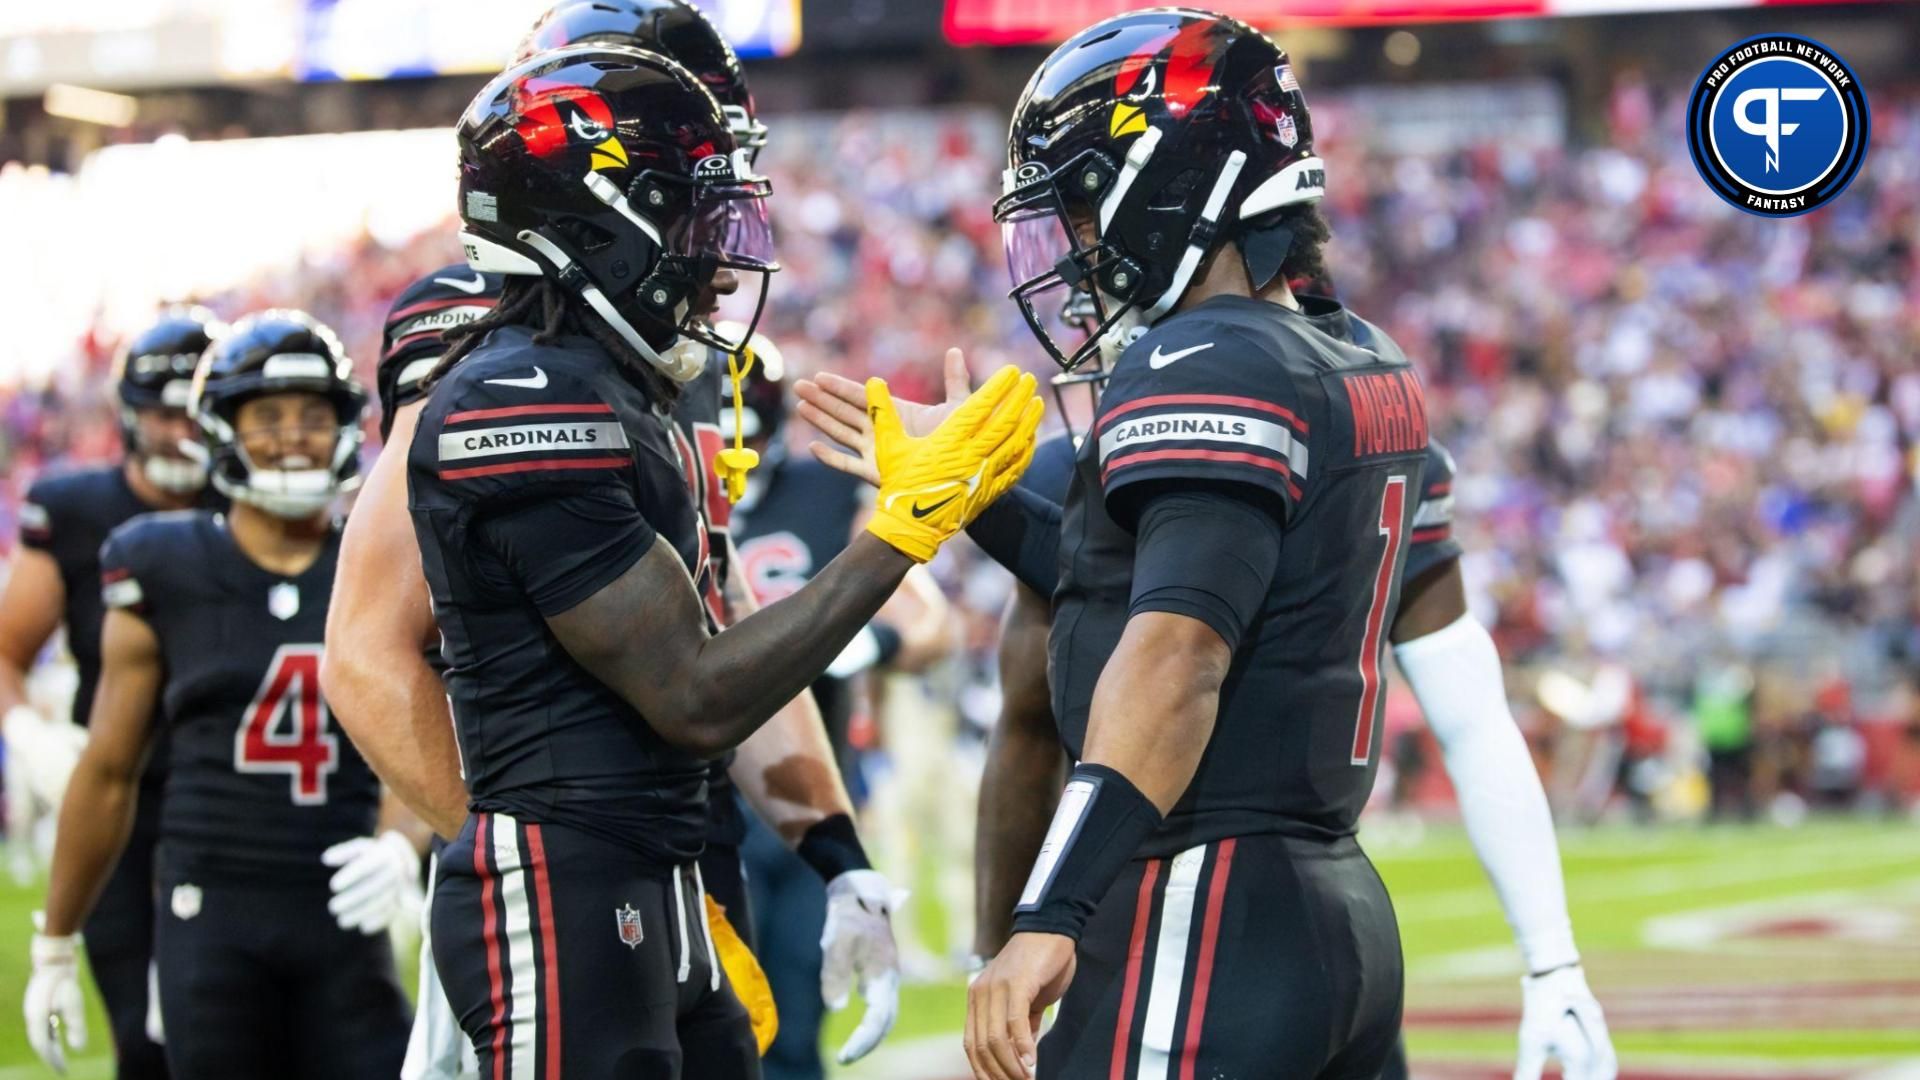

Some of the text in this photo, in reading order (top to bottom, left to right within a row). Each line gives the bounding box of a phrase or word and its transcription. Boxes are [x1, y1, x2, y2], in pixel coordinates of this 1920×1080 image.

[697, 168, 732, 177] OAKLEY
[464, 429, 597, 451] CARDINALS
[1116, 419, 1247, 442] CARDINALS
[1350, 475, 1407, 765] 1
[233, 643, 339, 806] 4
